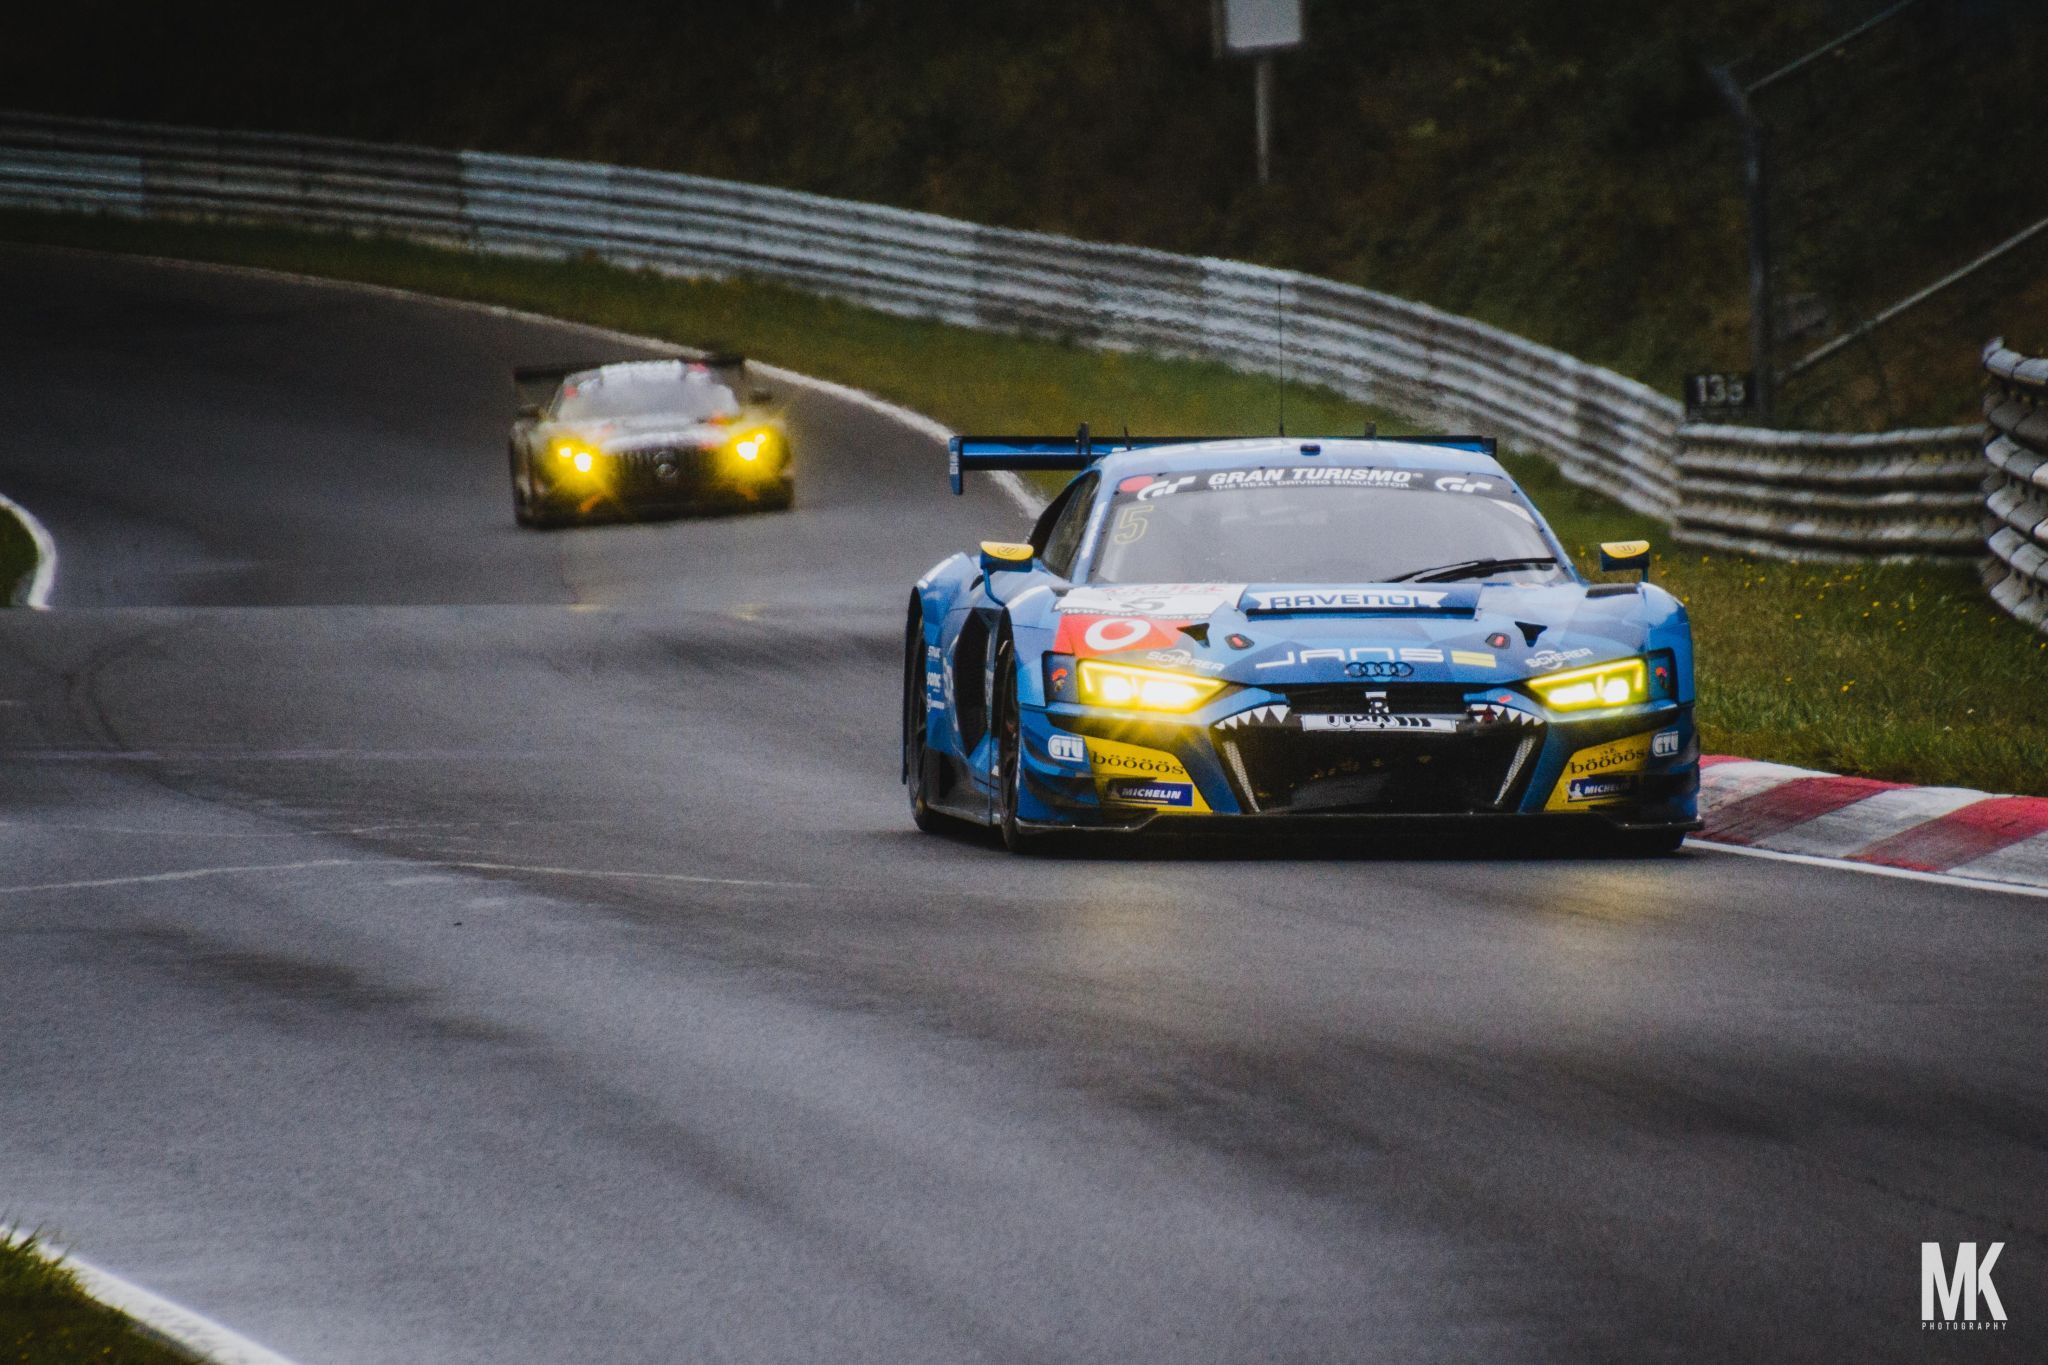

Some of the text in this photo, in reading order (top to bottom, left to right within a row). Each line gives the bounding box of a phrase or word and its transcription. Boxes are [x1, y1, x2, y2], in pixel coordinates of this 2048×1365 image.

[1208, 469, 1285, 486] GRAN
[1334, 480, 1410, 488] SIMULATOR
[1114, 505, 1154, 544] 5
[1269, 594, 1424, 608] RAVENOL
[1146, 650, 1225, 671] SCHERER
[1525, 648, 1594, 669] SCHERER
[1121, 787, 1182, 800] MICHELIN
